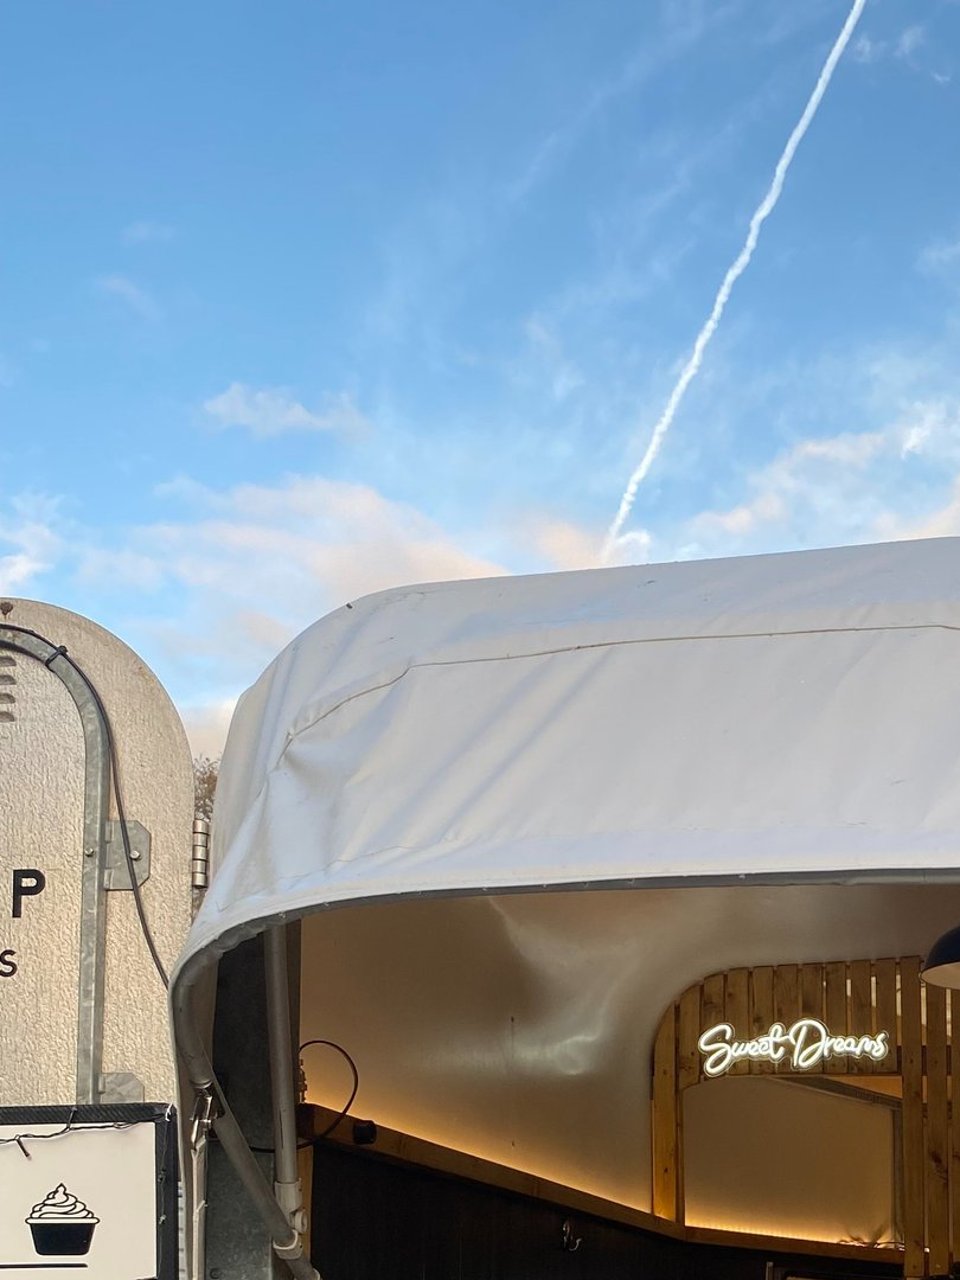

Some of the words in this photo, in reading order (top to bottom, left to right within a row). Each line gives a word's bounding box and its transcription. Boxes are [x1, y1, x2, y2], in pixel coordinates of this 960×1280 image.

[12, 868, 46, 918] P
[699, 1022, 788, 1075] Sweet
[789, 1018, 887, 1068] Dreams
